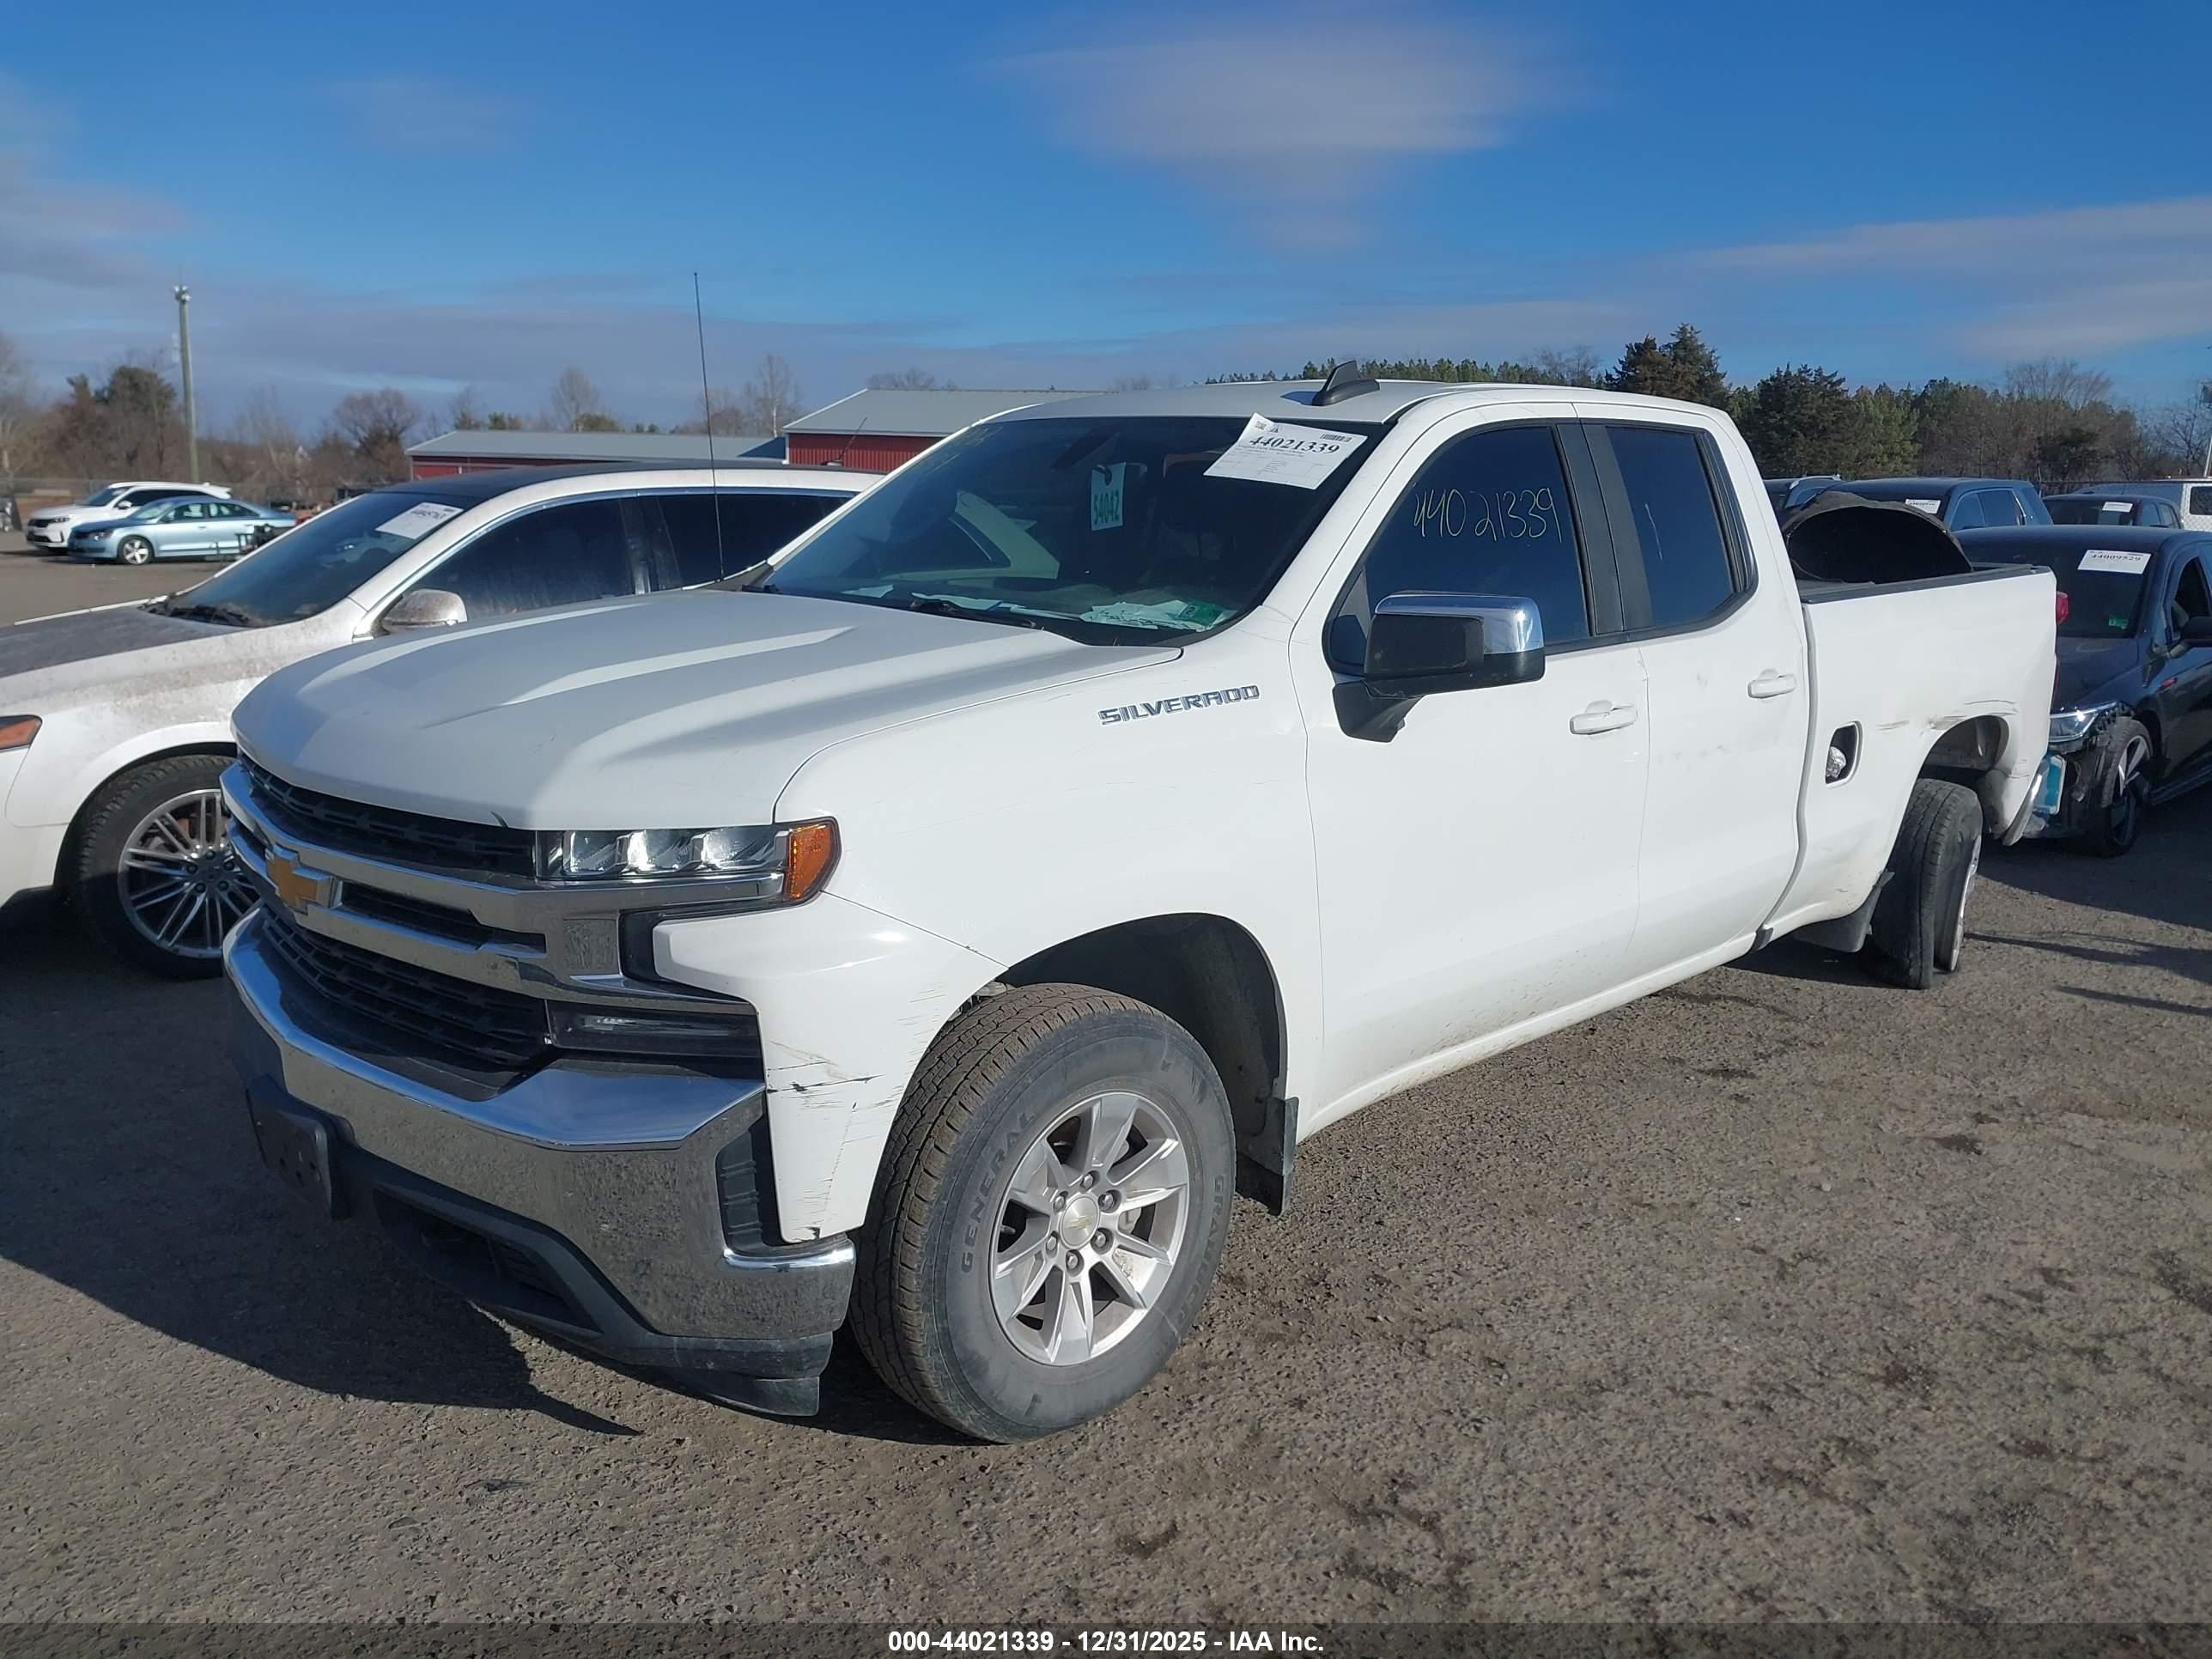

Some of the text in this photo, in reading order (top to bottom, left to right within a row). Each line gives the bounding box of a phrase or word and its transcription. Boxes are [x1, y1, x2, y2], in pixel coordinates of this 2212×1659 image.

[1249, 435, 1340, 454] 44021339
[1413, 487, 1562, 543] 44021339
[1098, 684, 1261, 726] SILVERADO
[961, 1112, 1036, 1273] GENERAL
